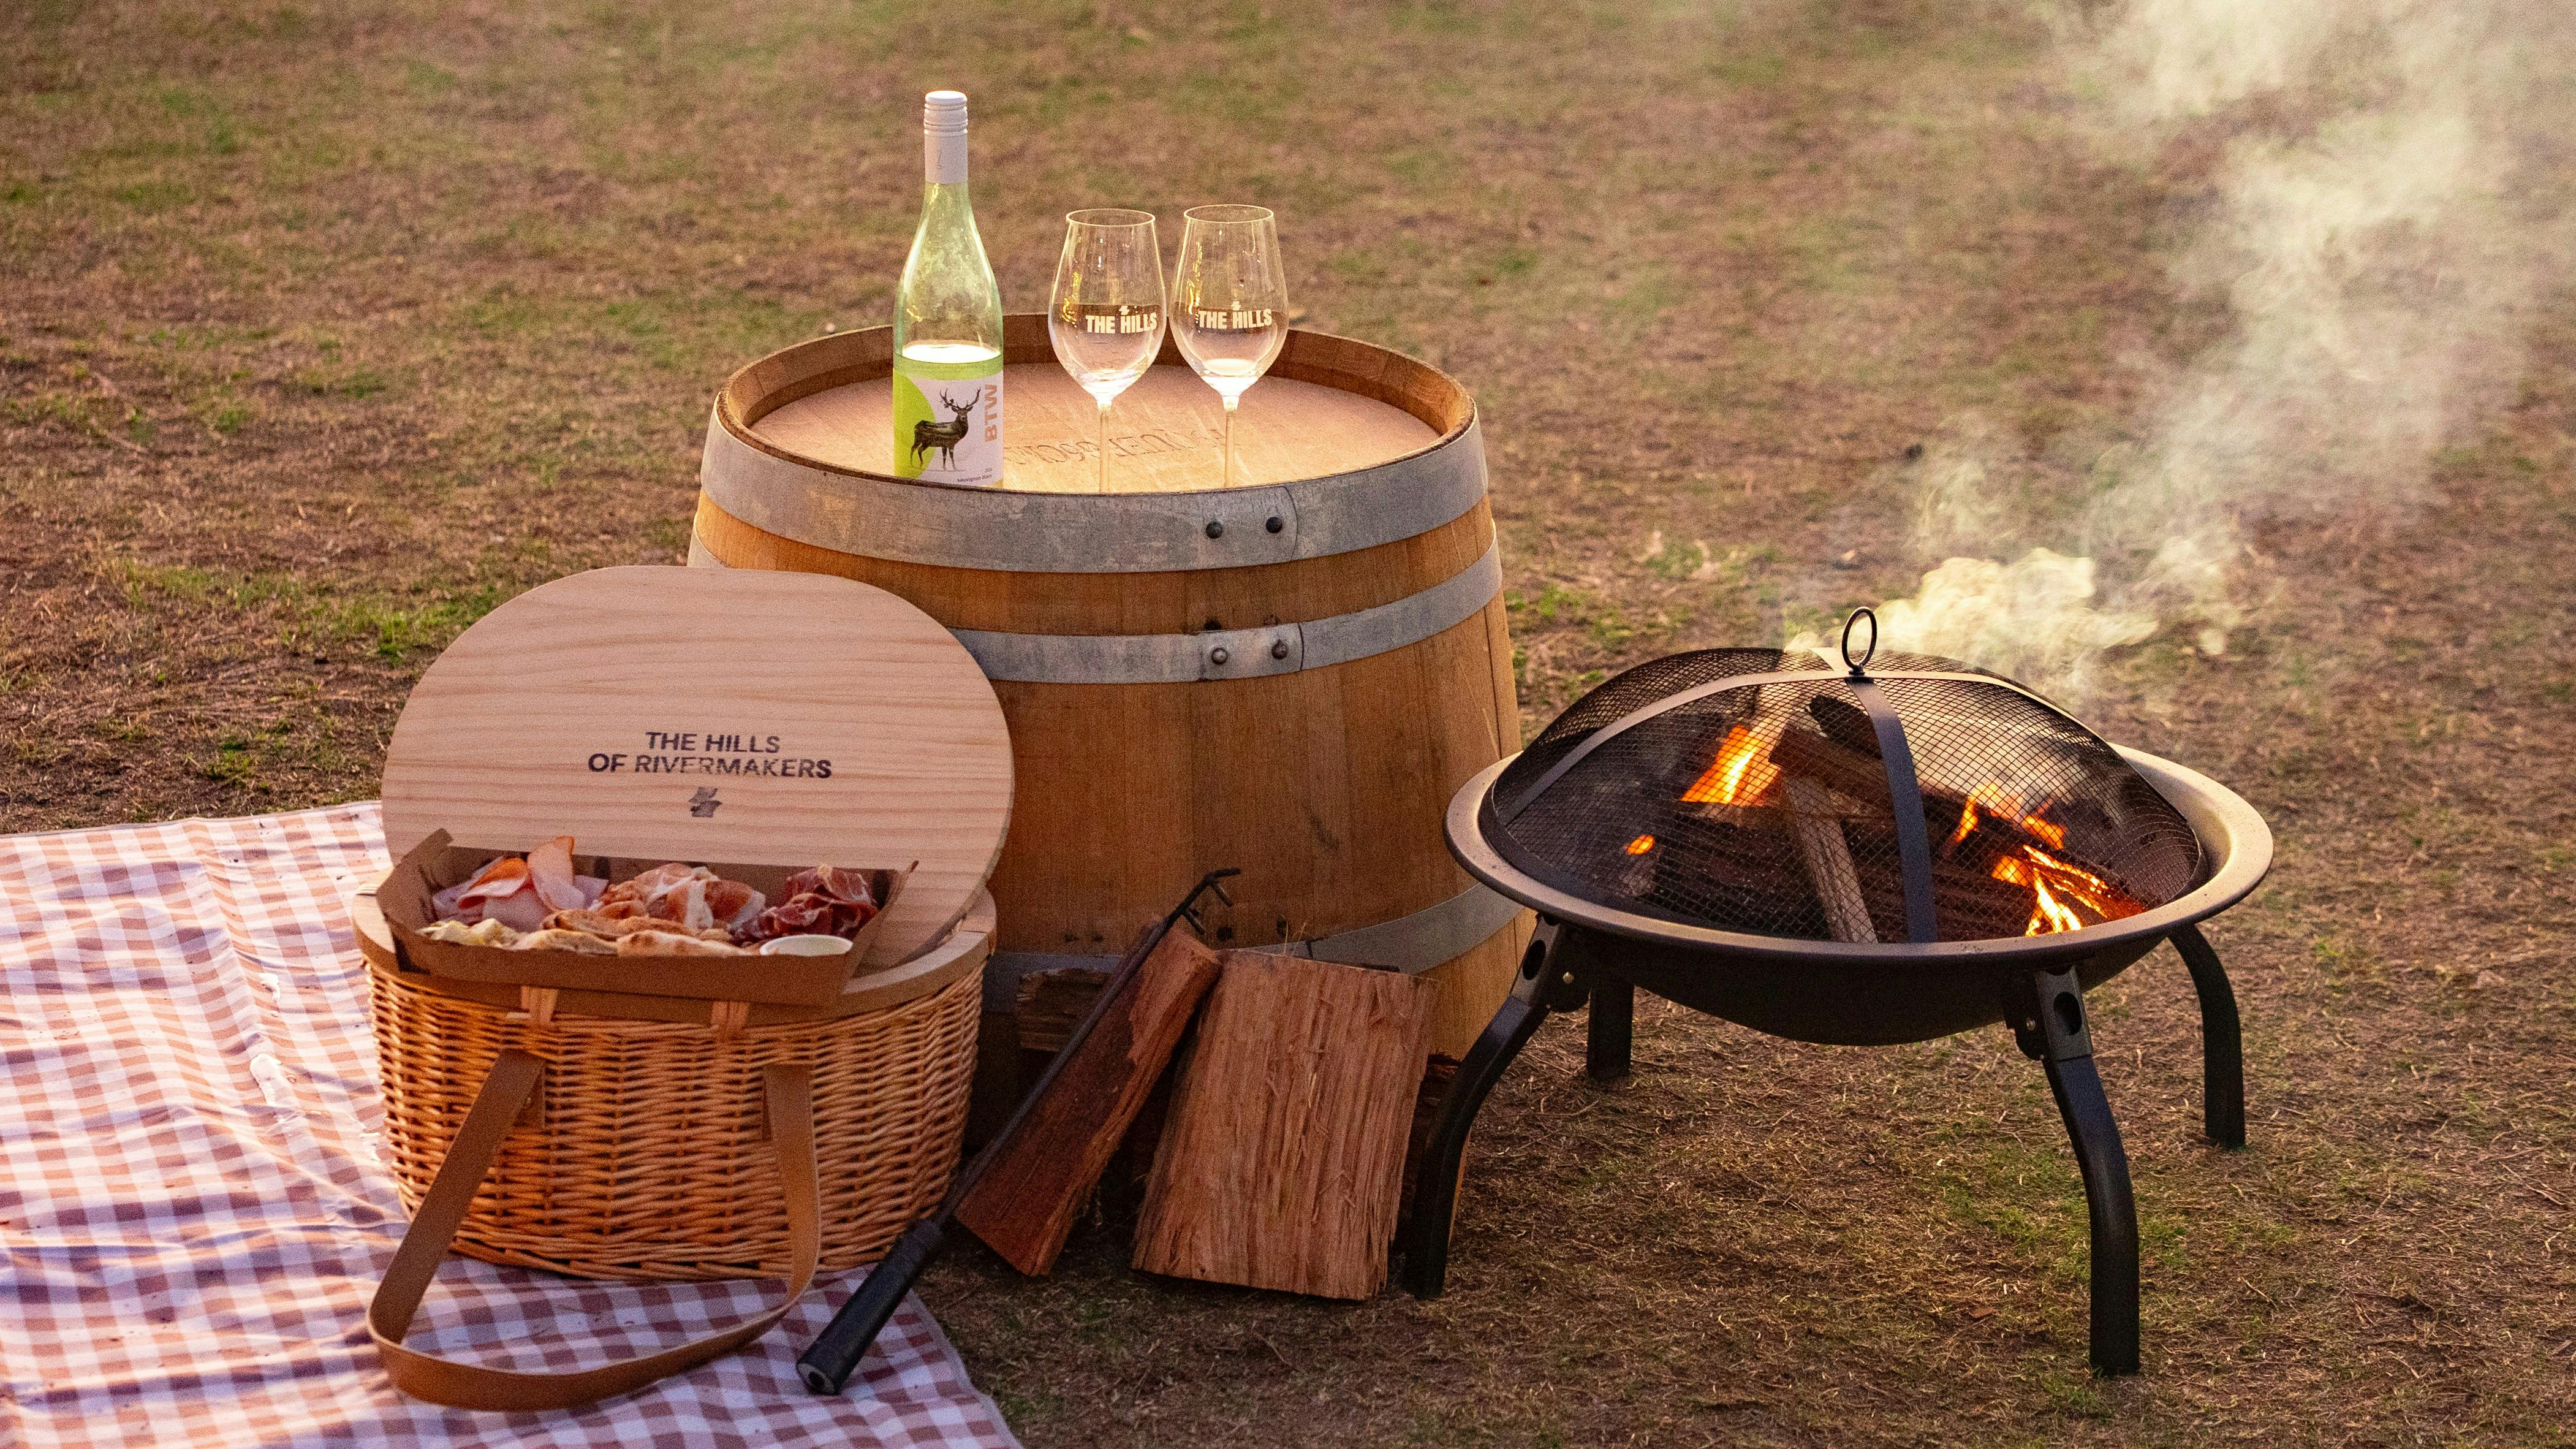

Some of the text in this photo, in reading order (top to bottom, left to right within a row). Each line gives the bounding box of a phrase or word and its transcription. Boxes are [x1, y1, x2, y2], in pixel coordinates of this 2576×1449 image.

[1085, 312, 1157, 334] THE HILLS
[1199, 308, 1273, 329] THE HILLS
[985, 384, 998, 442] BTW
[645, 732, 780, 753] THE HILLS
[588, 753, 832, 778] OF RIVERMAKERS
